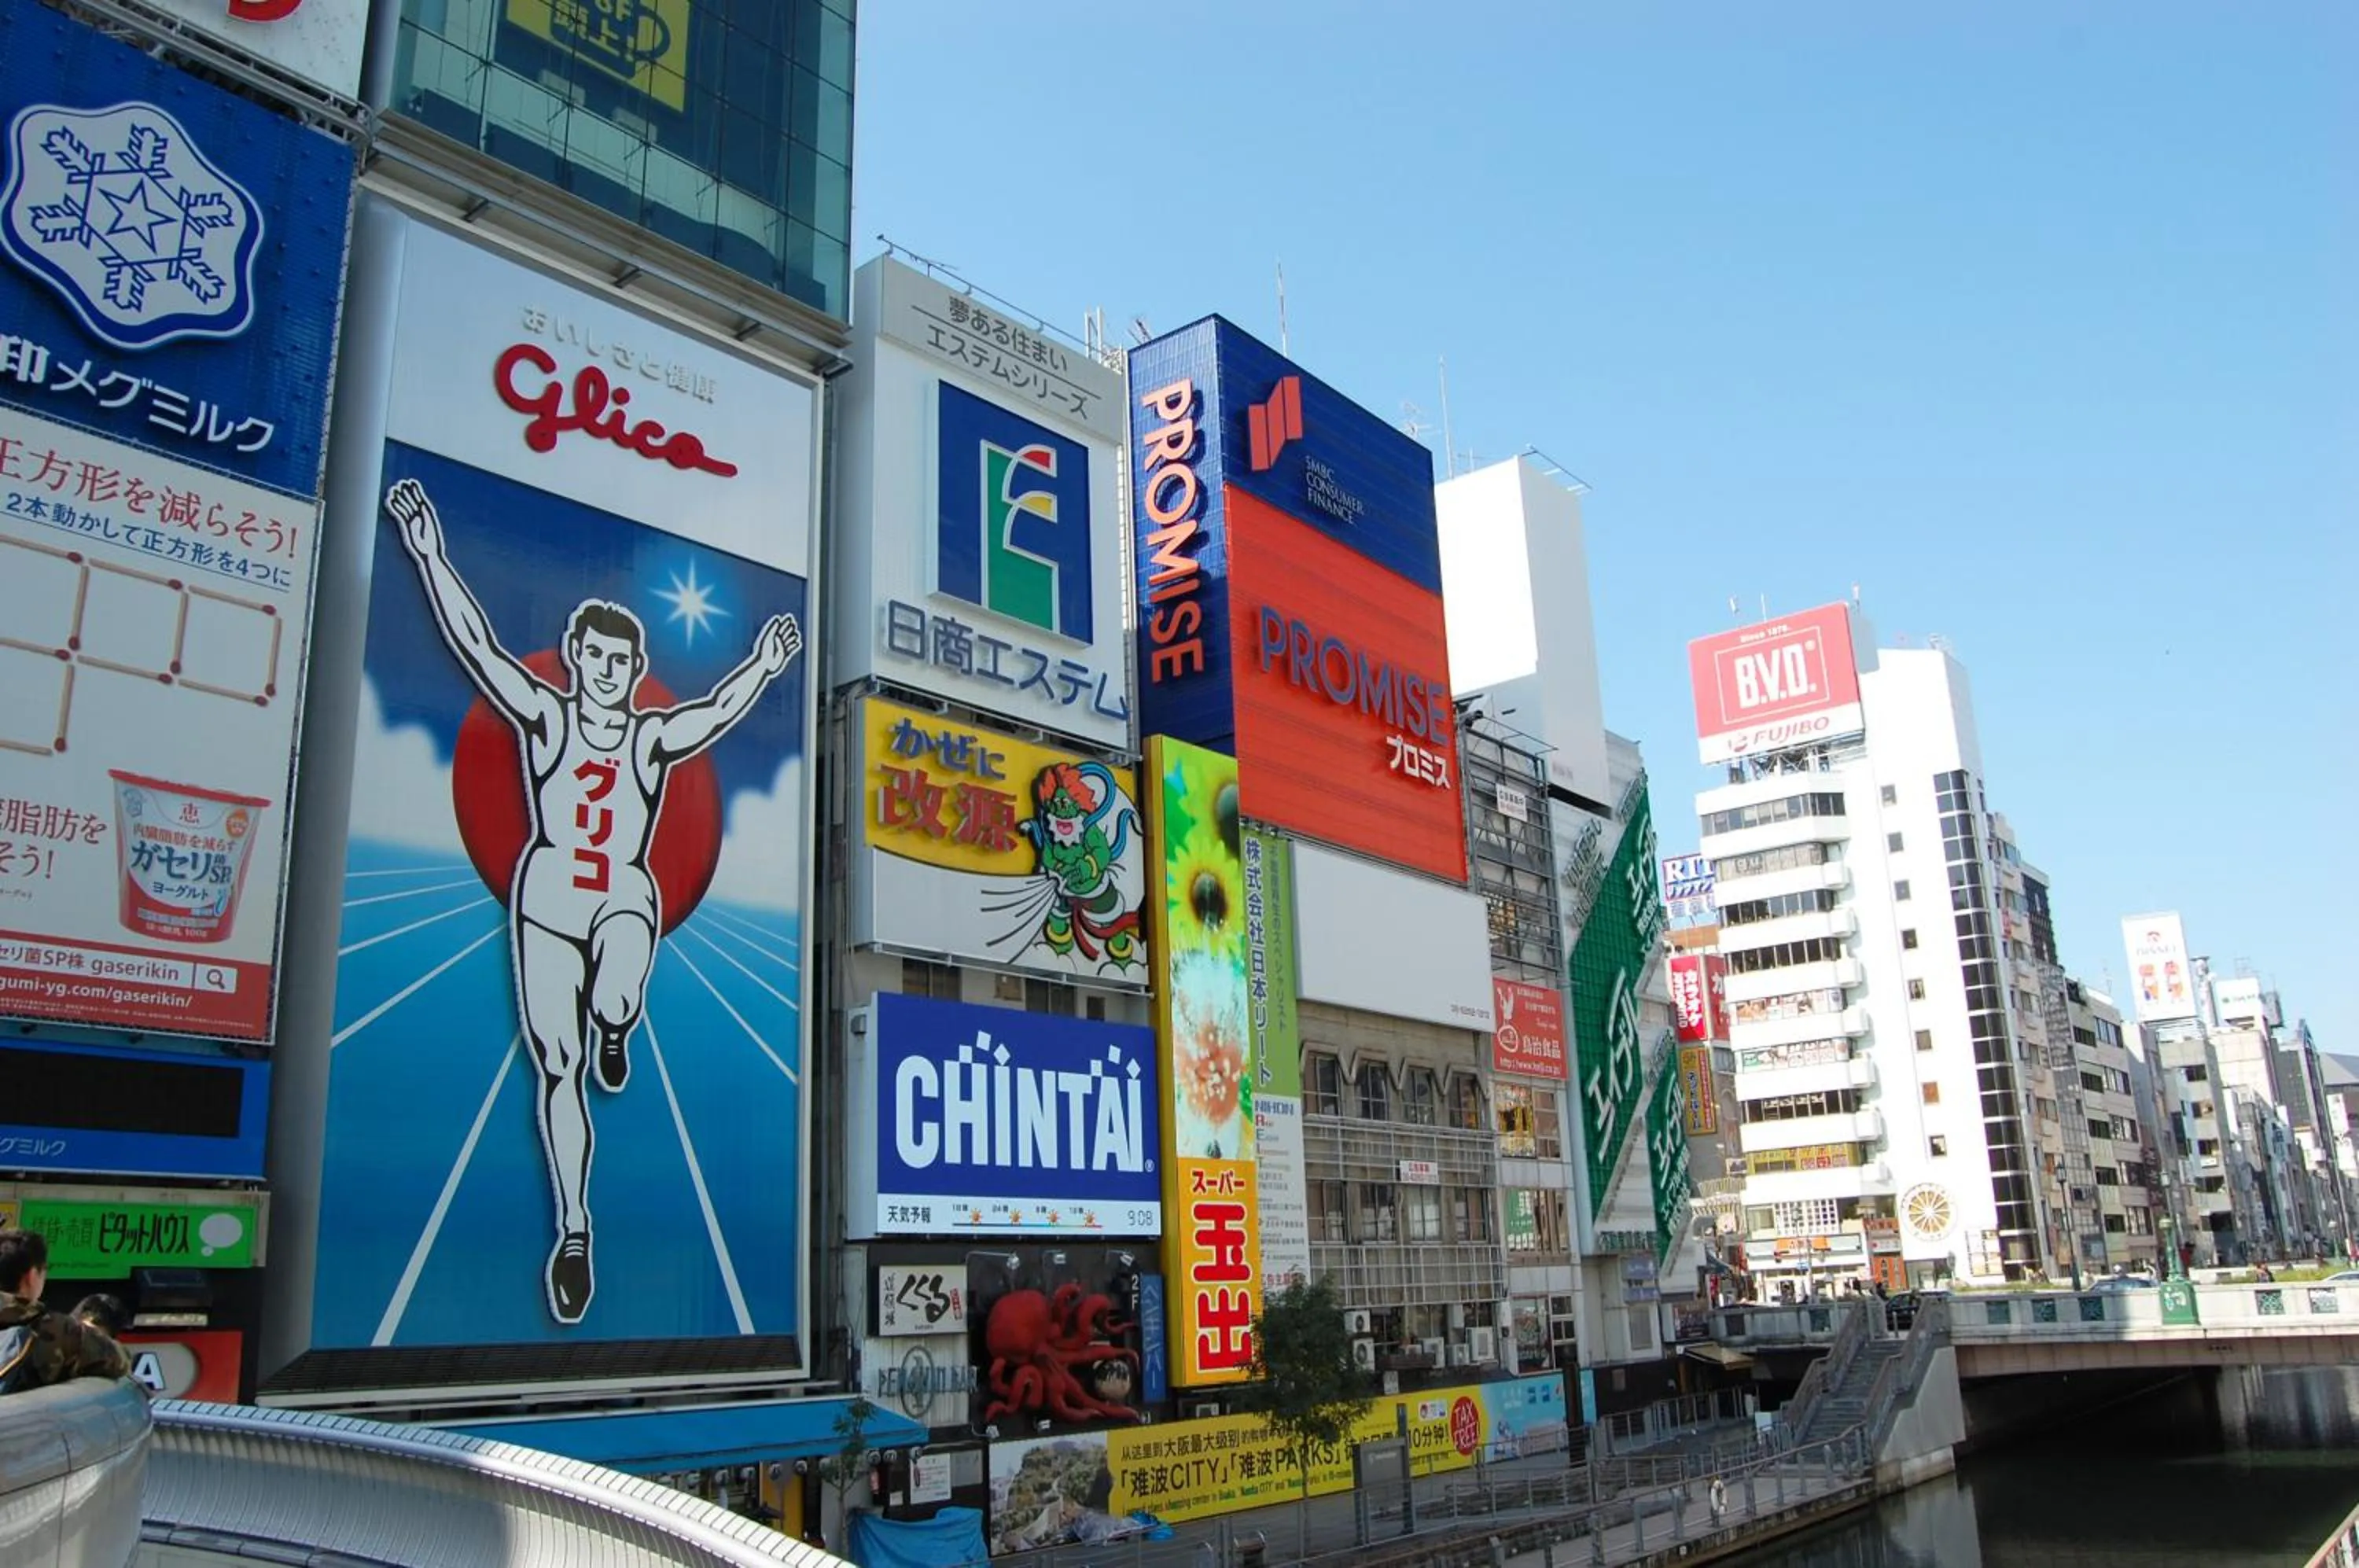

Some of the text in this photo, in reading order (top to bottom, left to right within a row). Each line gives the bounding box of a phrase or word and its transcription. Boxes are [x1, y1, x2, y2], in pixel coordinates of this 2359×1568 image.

[948, 296, 1068, 373] 夢ある住まい
[927, 324, 1089, 420] エステムシリーズ
[494, 343, 738, 478] Glico
[1305, 455, 1335, 484] SMBC
[1306, 472, 1364, 516] CONSUMER
[1141, 377, 1204, 683] PROMISE
[1308, 488, 1354, 525] FINANCE
[6, 493, 291, 587] 2本動かして正方形を4つに
[888, 598, 1131, 722] 日商エステム
[1259, 605, 1450, 746] PROMISE
[1734, 642, 1817, 709] B.V.D.
[891, 716, 1007, 781] かぜに
[1386, 735, 1451, 789] プロミス
[1754, 716, 1830, 745] FUJIBO
[572, 757, 621, 893] グリコ
[878, 764, 1018, 852] 改源
[131, 840, 213, 882] ガセリ
[153, 881, 209, 901] ヨーグルト
[91, 957, 179, 982] gaserikin
[1244, 836, 1272, 1088] 株式会社日本リート
[1587, 968, 1641, 1165] エイブル
[896, 1030, 1144, 1172] CHINTAI
[887, 1205, 932, 1224] 天気予報
[1192, 1170, 1245, 1194] スーパー
[98, 1211, 190, 1254] ピタットハウス
[896, 1273, 951, 1323] くくる
[1192, 1203, 1252, 1371] 玉出
[1455, 1401, 1475, 1424] TAX
